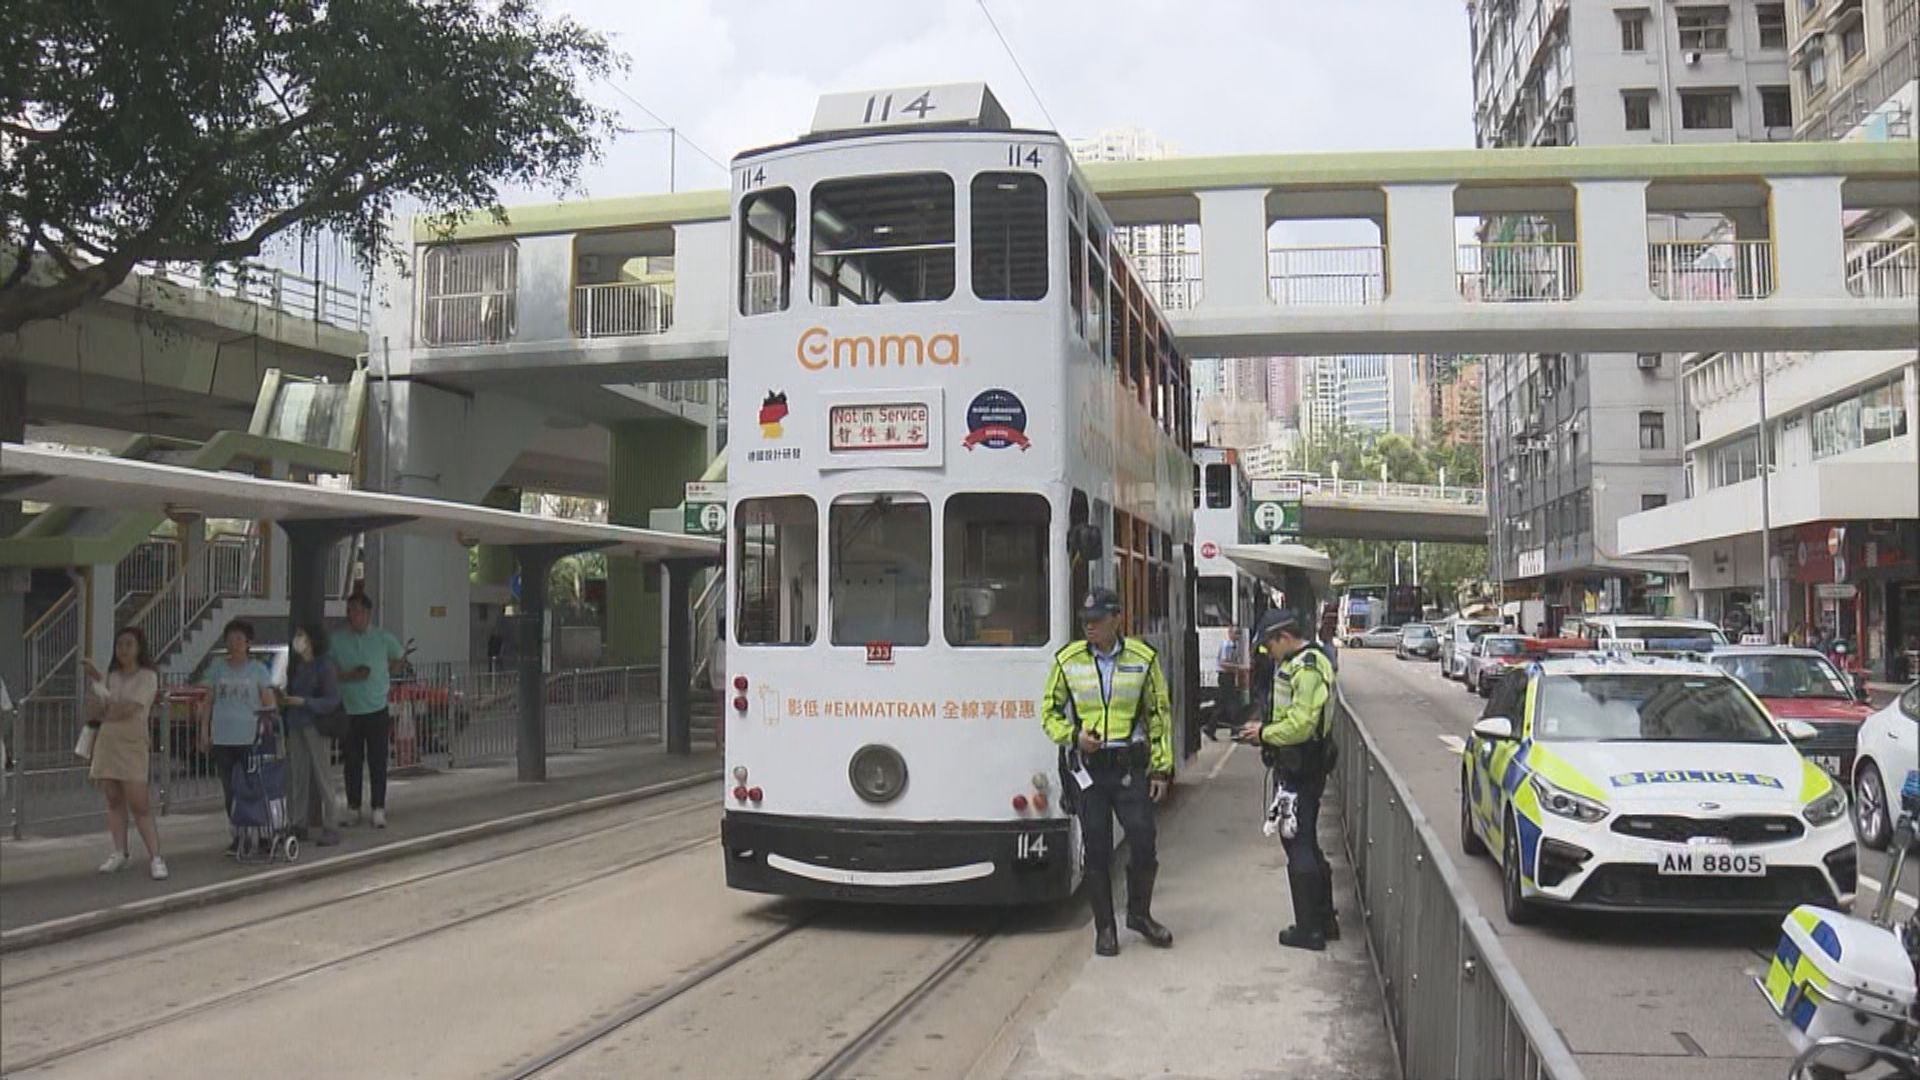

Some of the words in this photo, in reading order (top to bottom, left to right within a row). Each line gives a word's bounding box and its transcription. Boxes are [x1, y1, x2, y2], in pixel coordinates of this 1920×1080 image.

[863, 90, 935, 123] 114
[1009, 144, 1042, 168] 114
[742, 166, 766, 191] 114
[797, 326, 960, 371] Emma
[835, 407, 857, 423] Not
[863, 409, 873, 422] in
[880, 406, 925, 423] Service
[824, 701, 936, 719] #EMMATRAM
[942, 701, 1036, 719] 全線享優惠
[1643, 770, 1752, 784] POLICE
[1018, 833, 1048, 859] 114
[1663, 854, 1692, 873] AM
[1703, 855, 1762, 873] 8805
